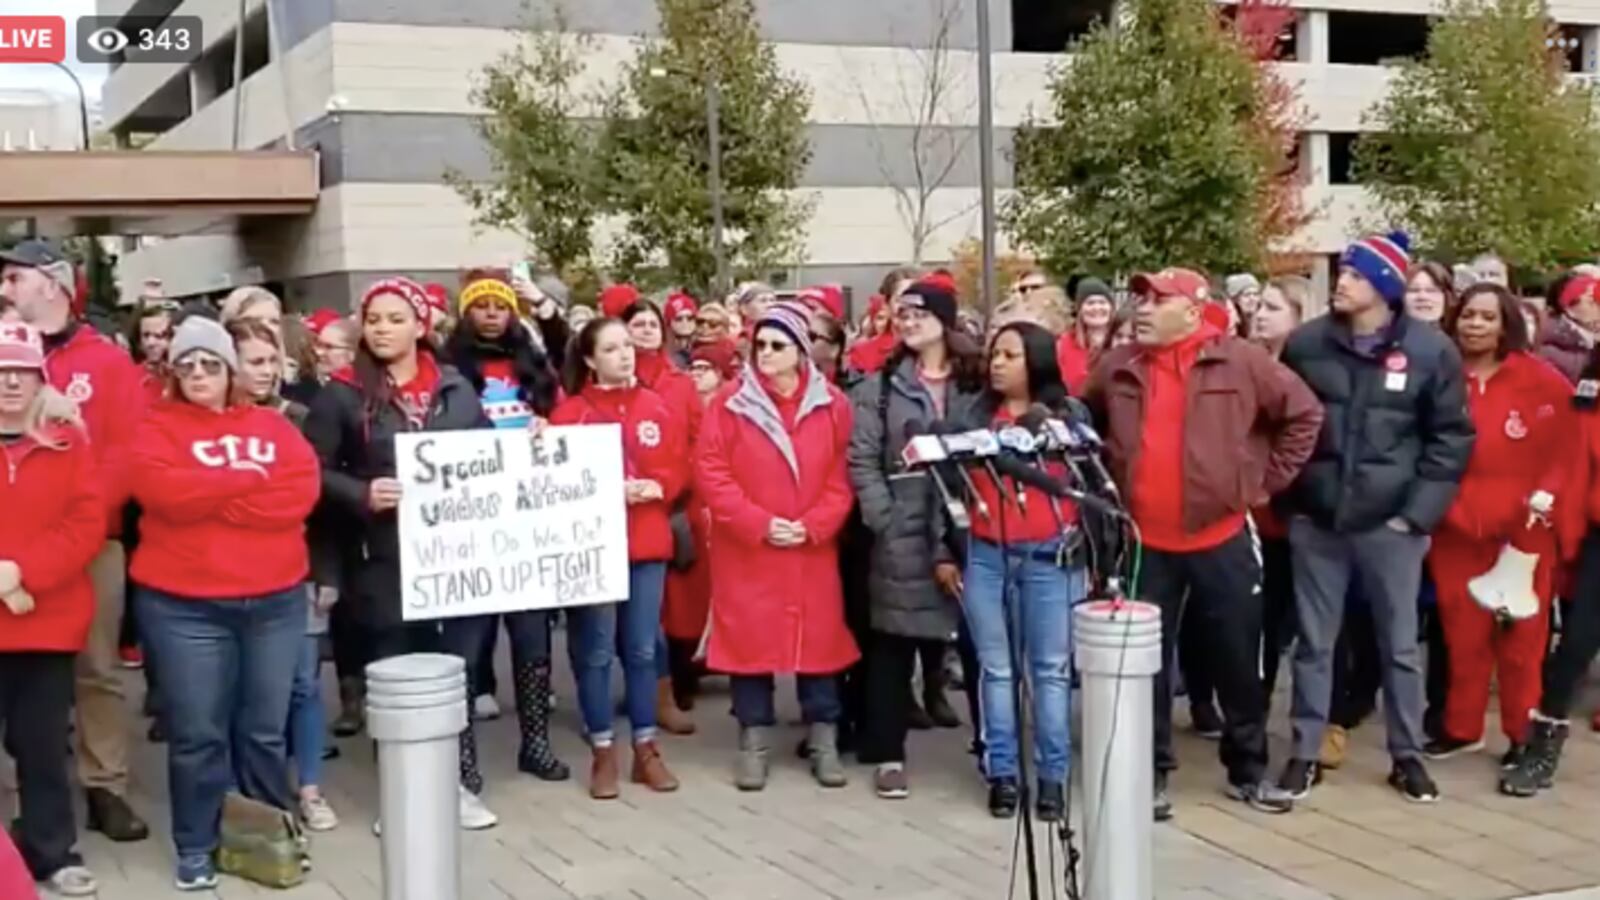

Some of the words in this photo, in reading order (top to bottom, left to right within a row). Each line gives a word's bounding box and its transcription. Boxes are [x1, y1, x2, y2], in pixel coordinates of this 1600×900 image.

[191, 433, 276, 470] CTU
[413, 438, 504, 489] Special
[529, 433, 569, 467] Ed
[413, 530, 480, 569] What
[492, 529, 520, 556] Do
[533, 526, 564, 550] We
[410, 566, 493, 610] STAND
[501, 560, 533, 593] UP
[538, 545, 606, 587] FIGHT
